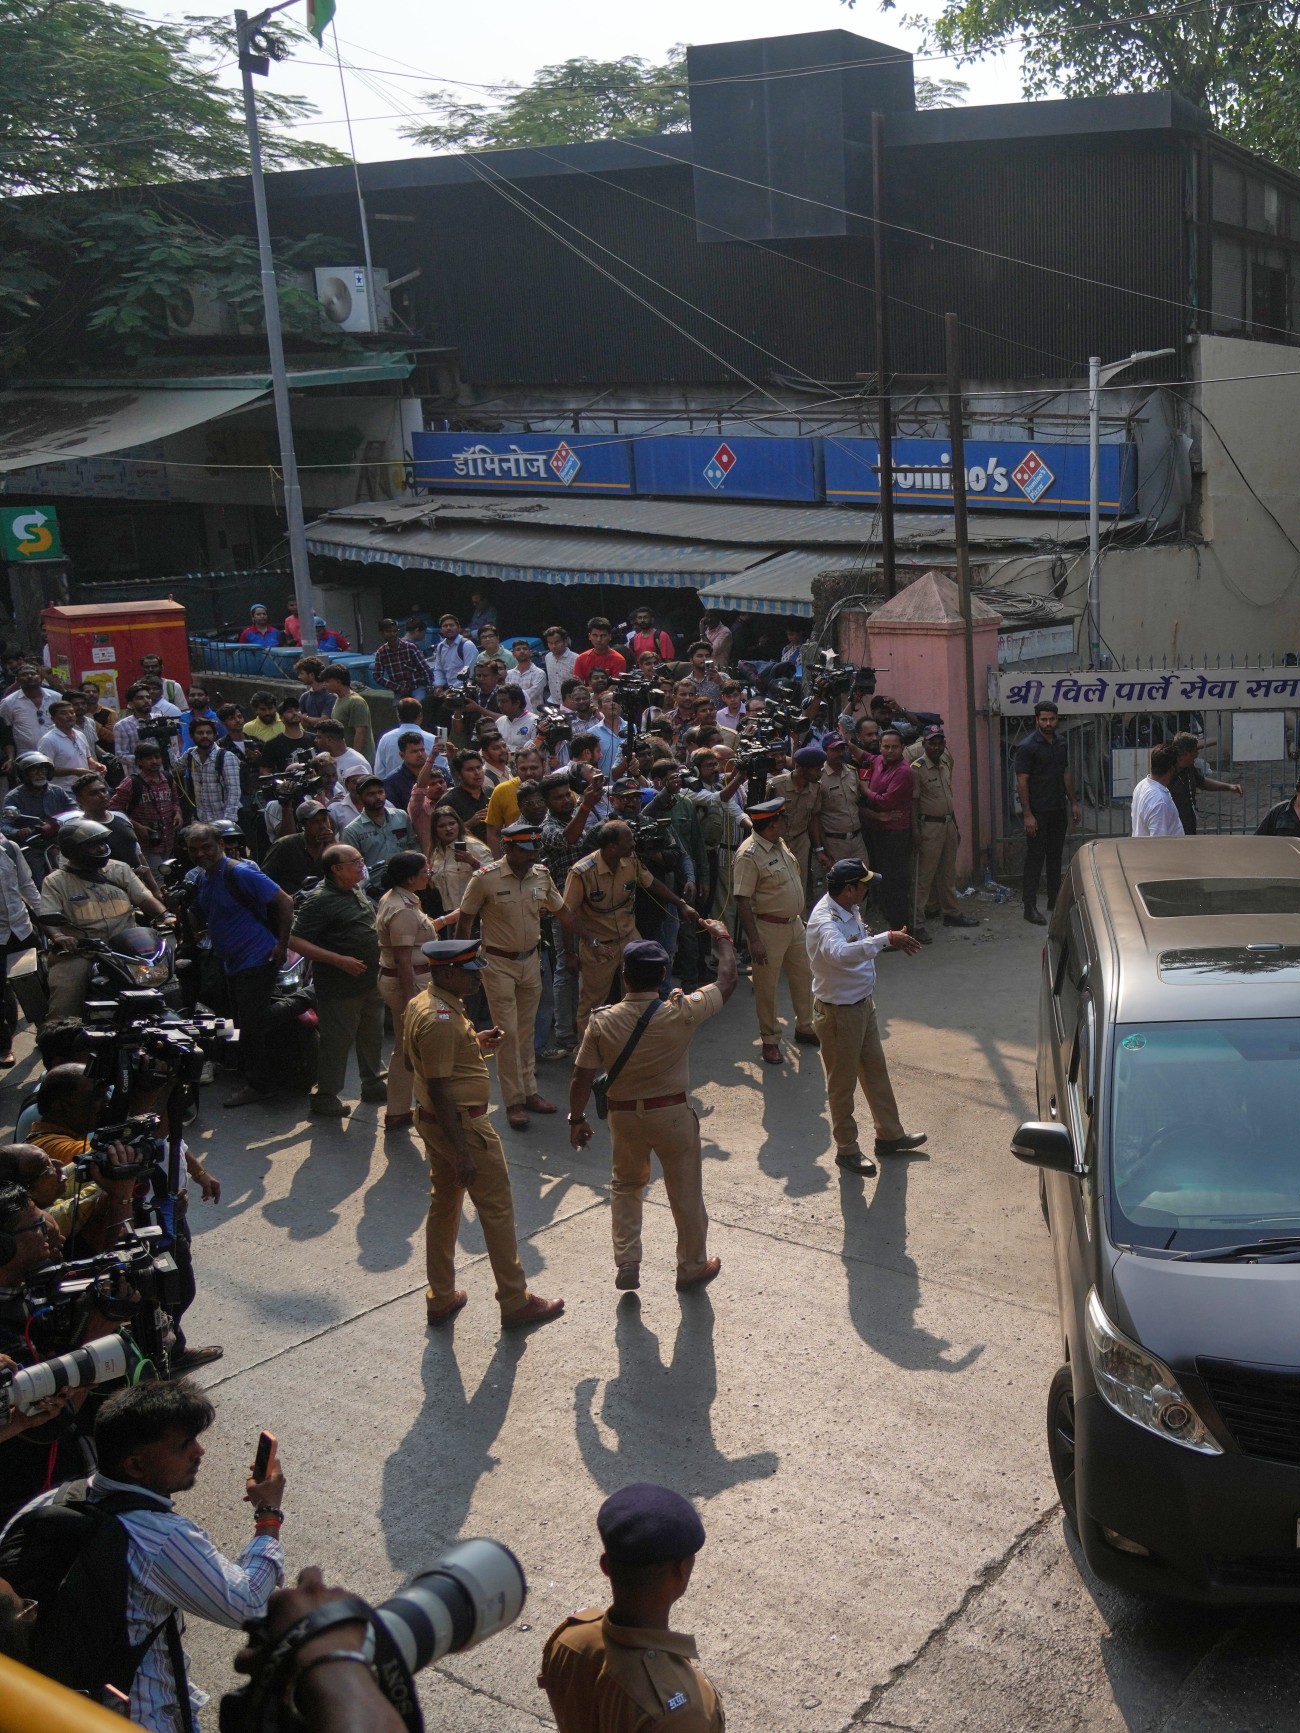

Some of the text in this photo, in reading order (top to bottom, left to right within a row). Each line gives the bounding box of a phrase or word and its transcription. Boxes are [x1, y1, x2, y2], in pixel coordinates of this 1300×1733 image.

[452, 444, 548, 478] डॉमिनोज
[877, 452, 1009, 493] omio's
[1024, 469, 1046, 493] Domino's
[1029, 483, 1044, 499] Pizza
[1006, 680, 1045, 704] श्री
[1051, 678, 1109, 703] विले
[1180, 676, 1239, 699] सेवा
[121, 1069, 129, 1093] Canon
